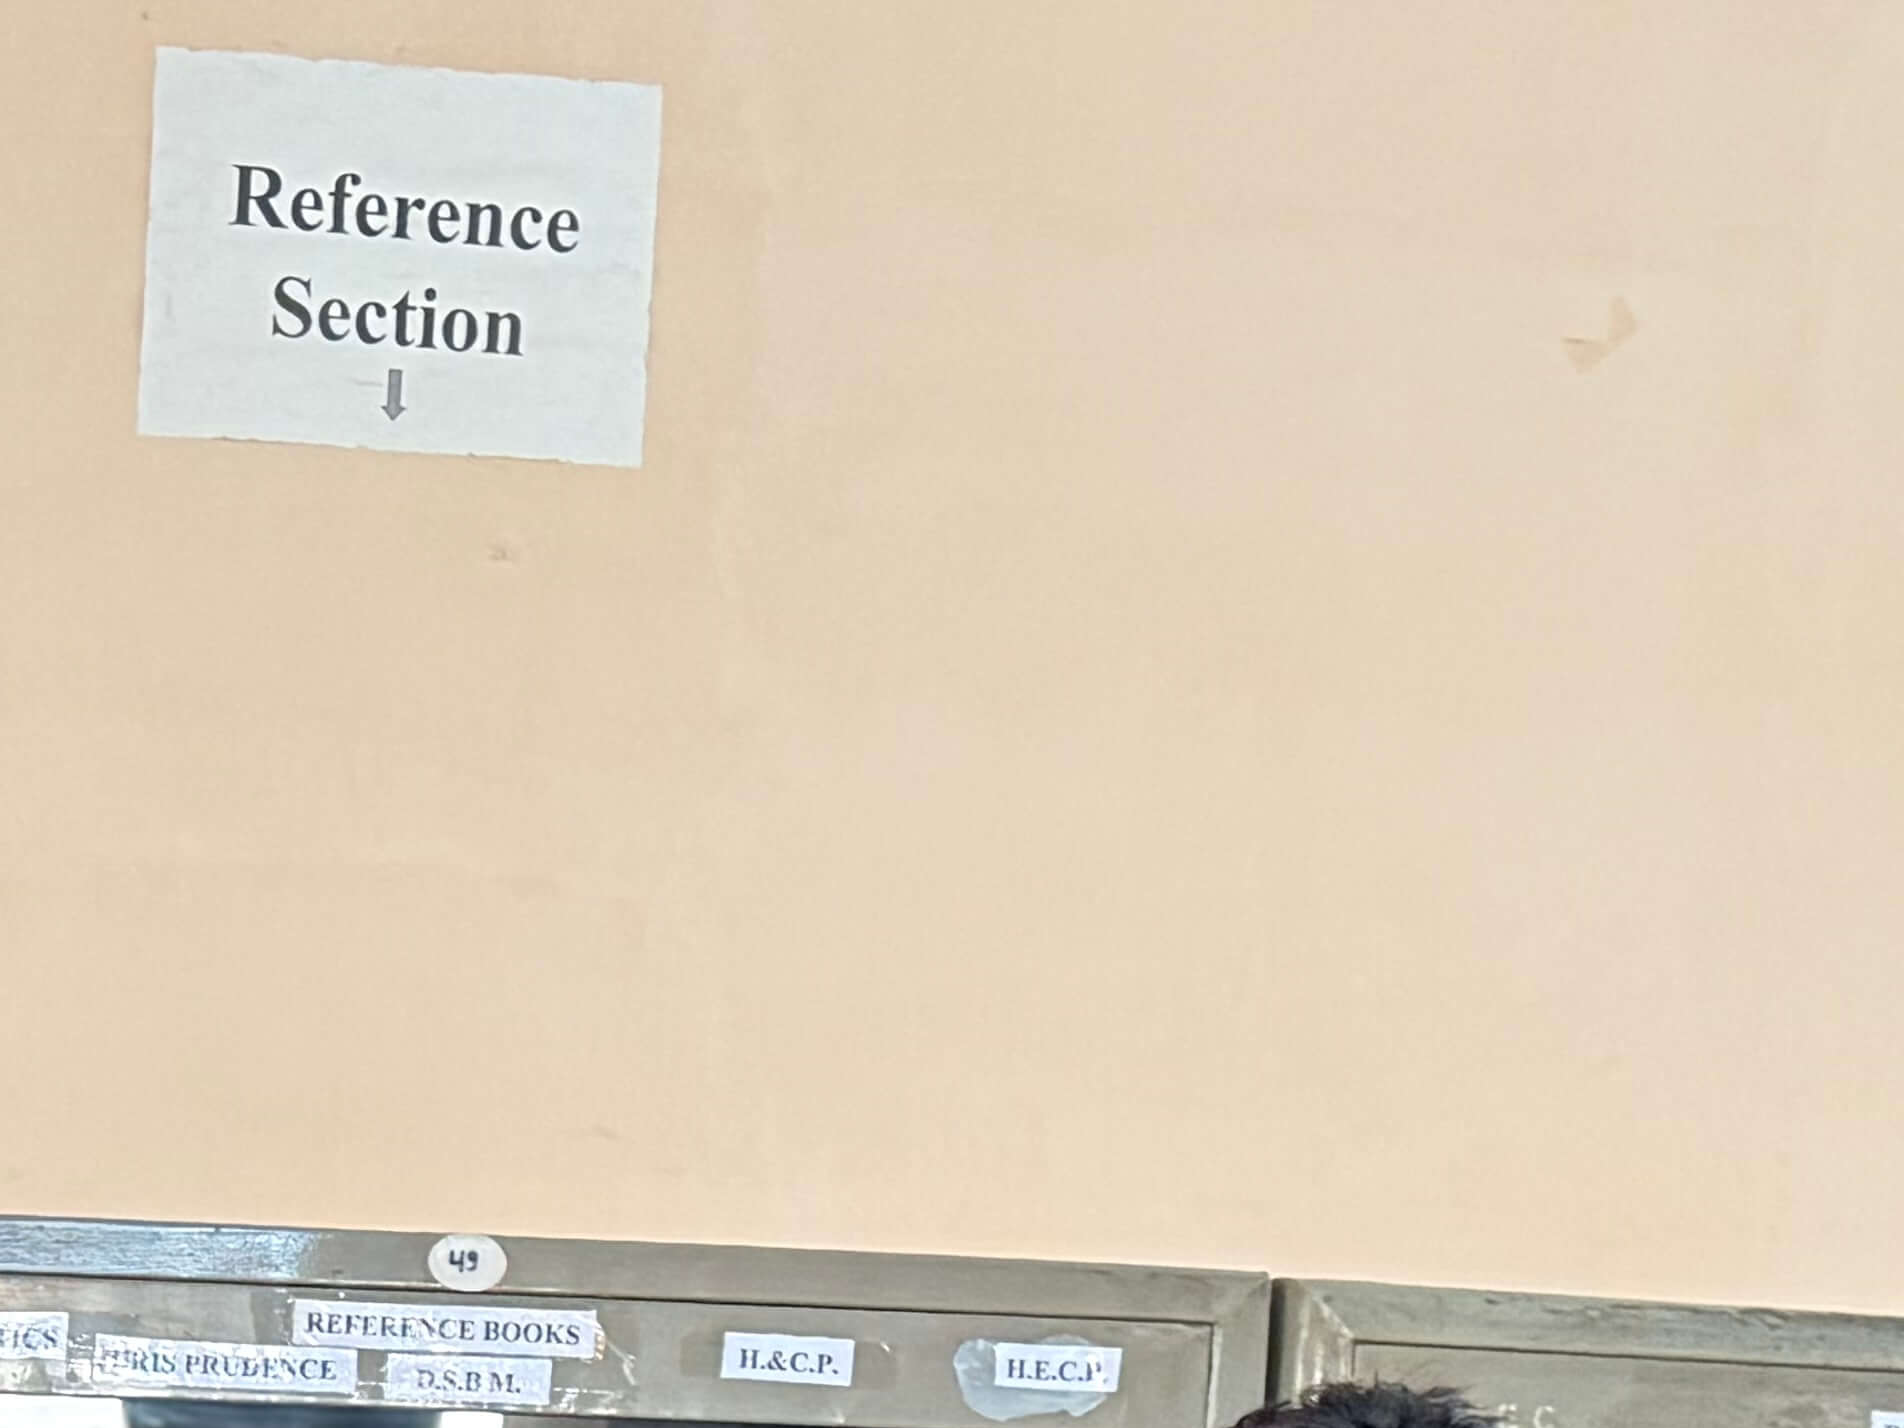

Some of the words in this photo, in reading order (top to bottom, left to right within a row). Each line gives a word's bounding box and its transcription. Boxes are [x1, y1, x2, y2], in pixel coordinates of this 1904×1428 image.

[229, 164, 579, 253] Reference
[272, 277, 523, 355] Section
[306, 1311, 474, 1341] REFERENCE
[483, 1320, 580, 1345] BOOKS
[739, 1348, 839, 1376] H.&C.P.
